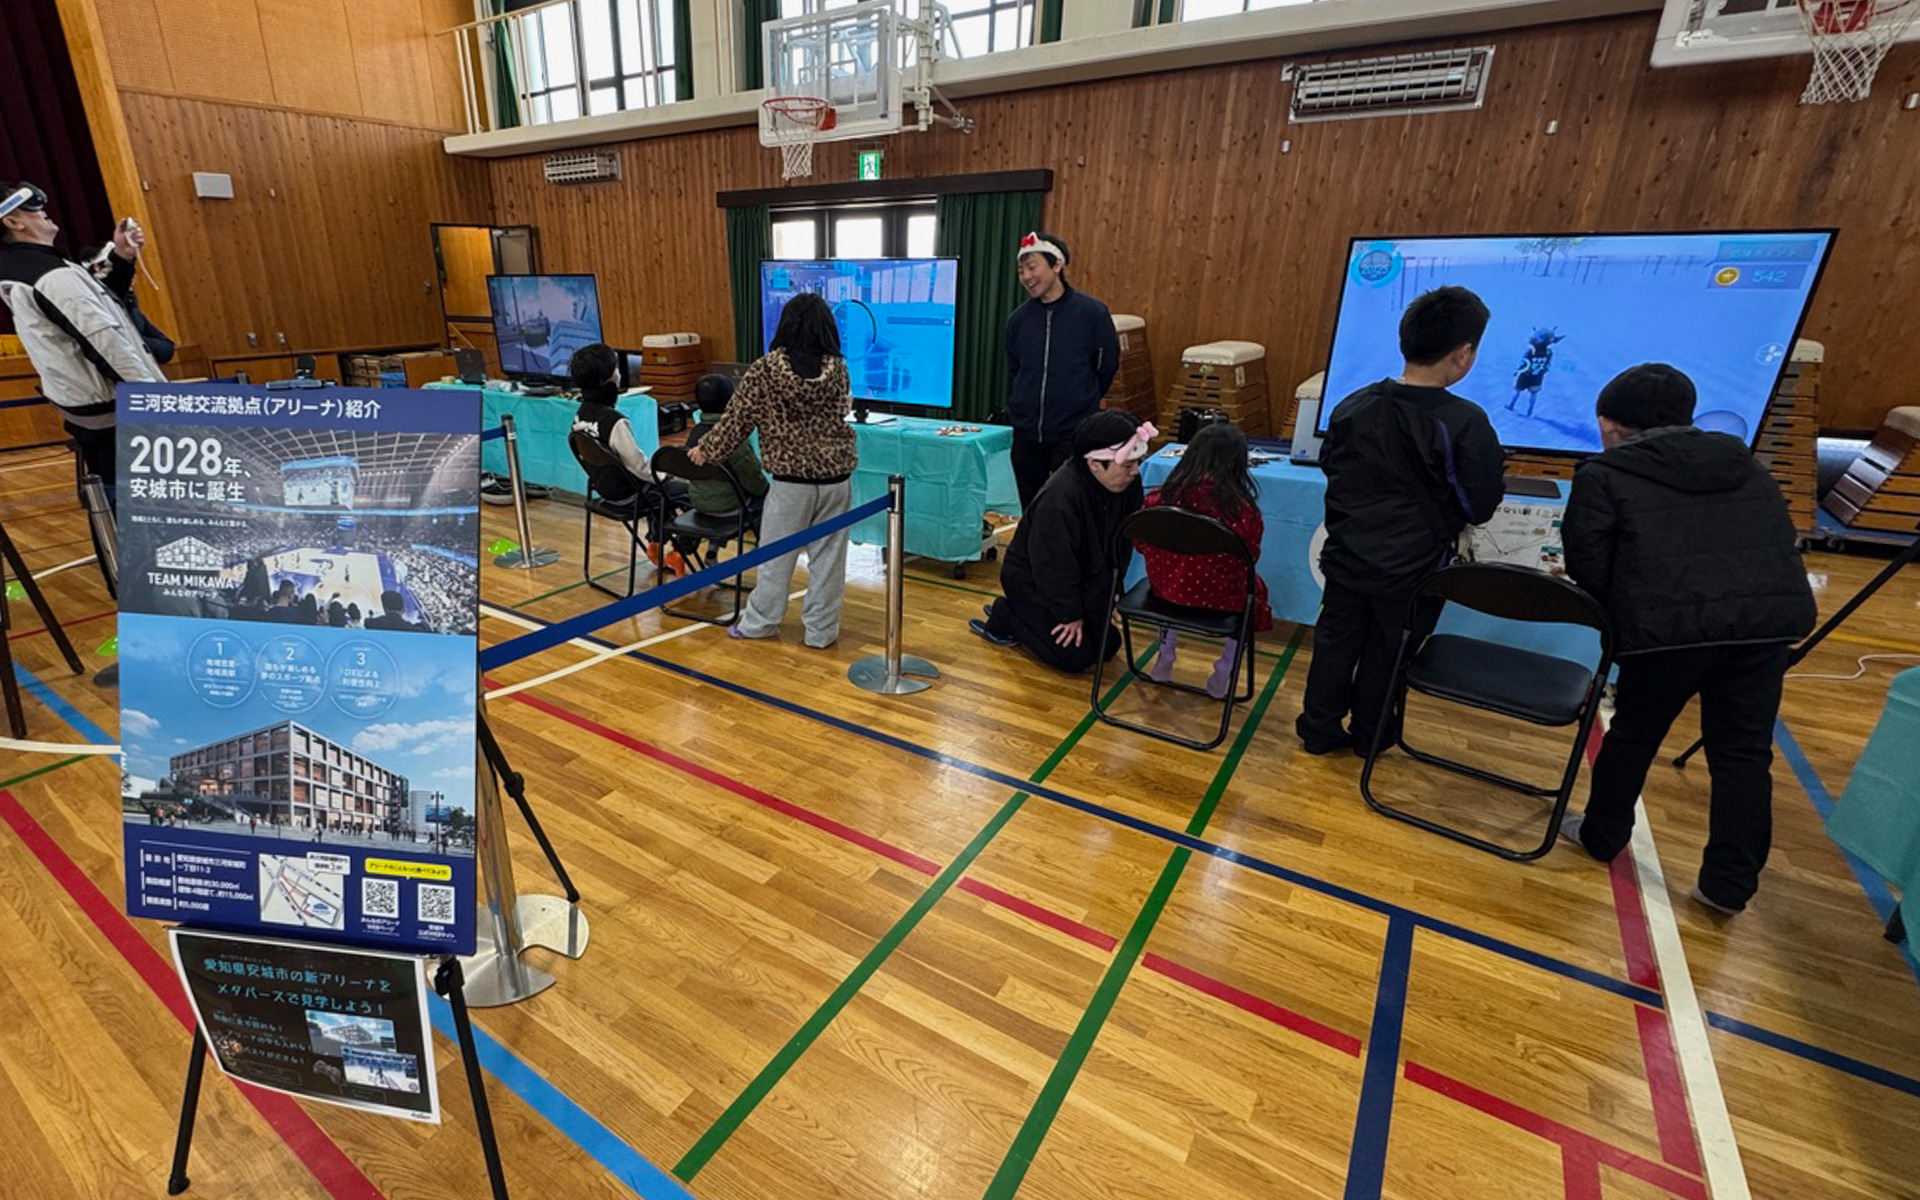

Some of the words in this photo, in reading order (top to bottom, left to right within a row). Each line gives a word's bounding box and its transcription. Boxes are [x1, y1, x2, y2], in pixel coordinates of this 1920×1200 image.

[1752, 270, 1787, 283] 542
[130, 478, 246, 503] 安城市に誕生
[147, 572, 180, 587] TEAM
[184, 574, 235, 590] MIKAWA
[217, 642, 223, 655] 1
[286, 647, 295, 660] 2
[356, 651, 366, 665] 3
[204, 957, 392, 993] 愛知県安城市の新アリーナを
